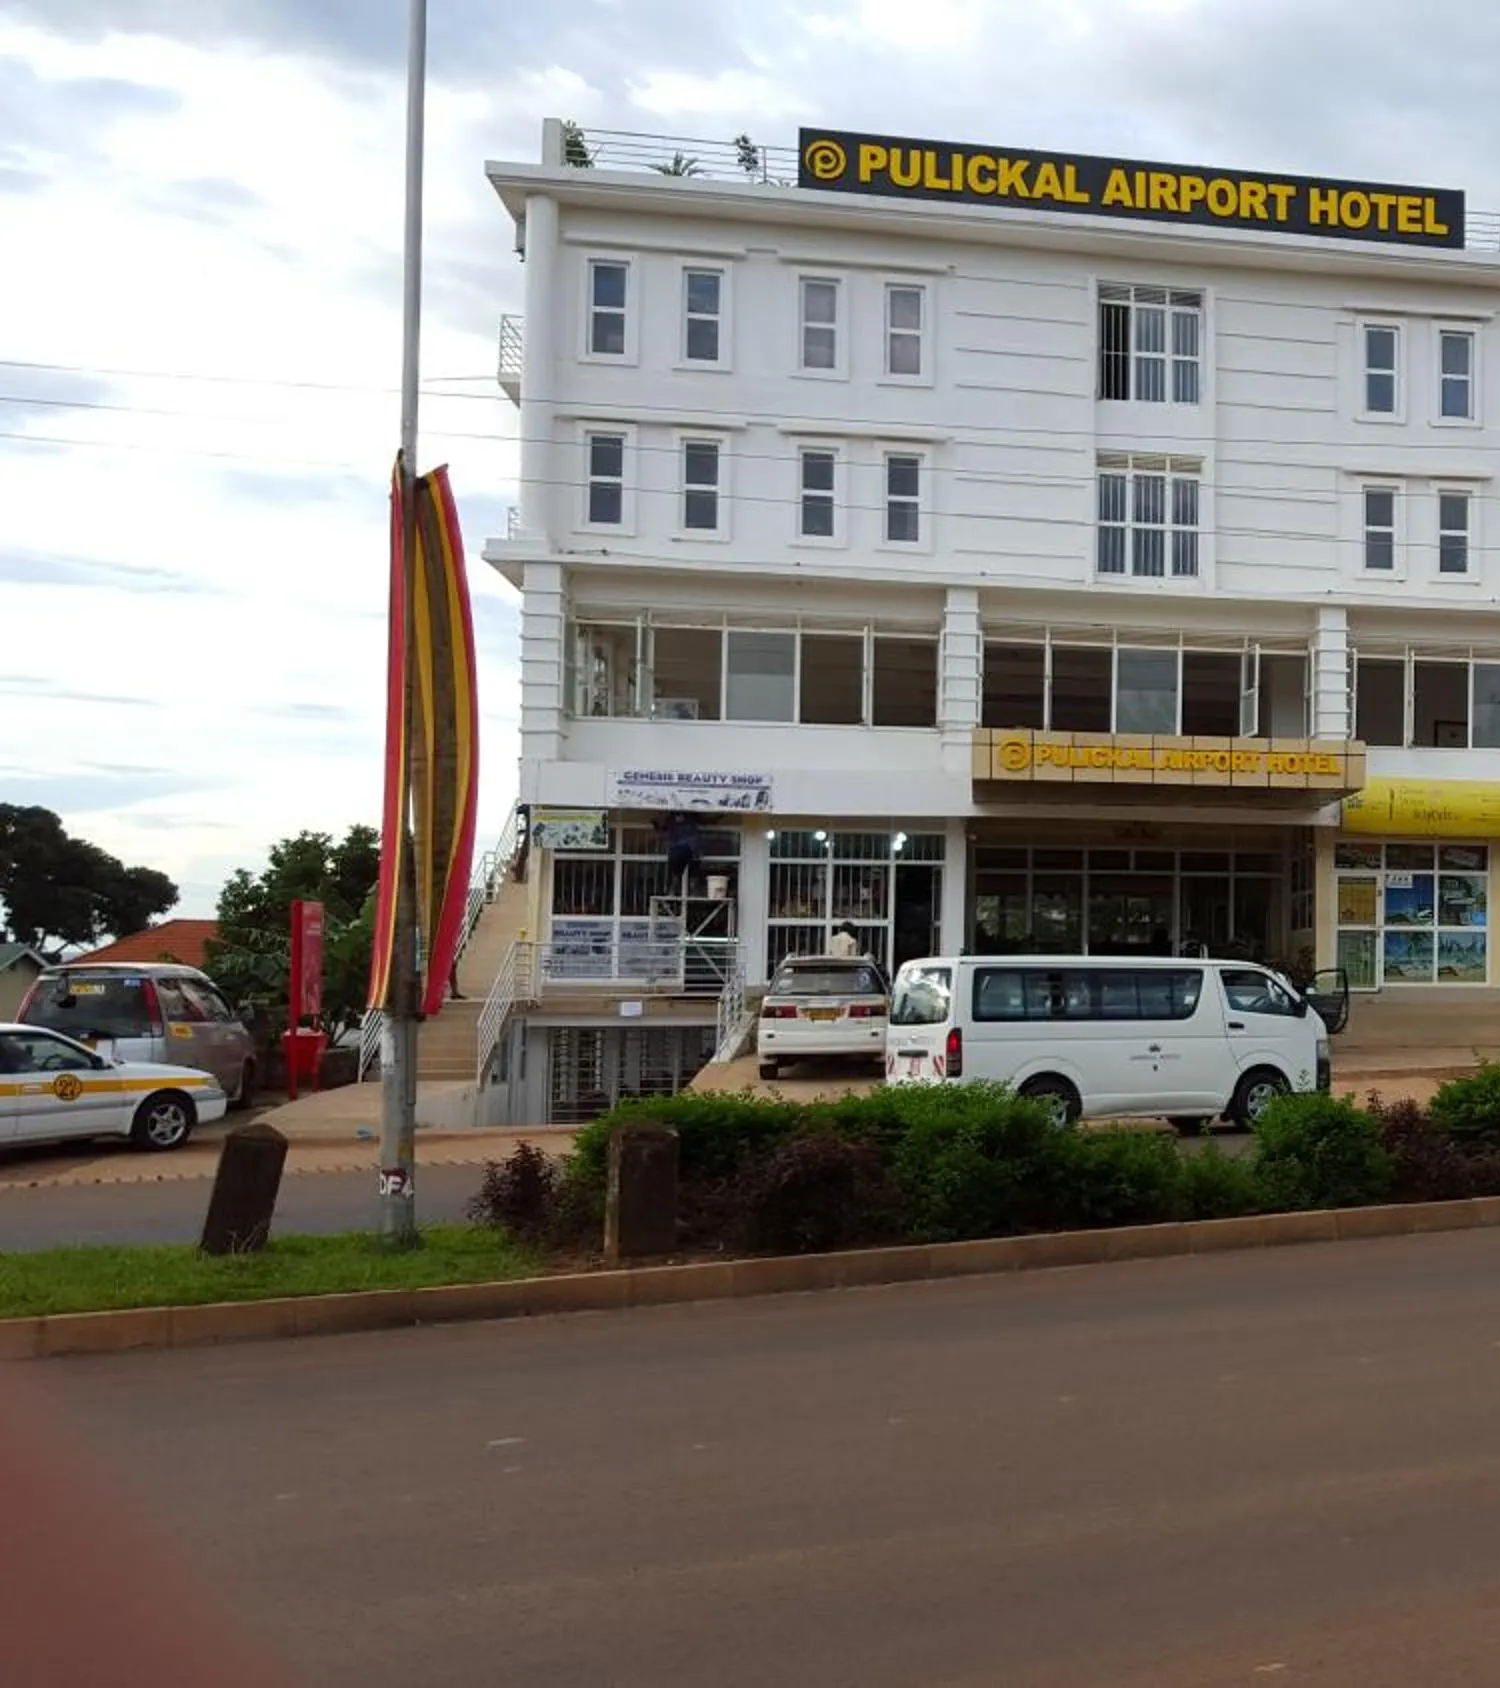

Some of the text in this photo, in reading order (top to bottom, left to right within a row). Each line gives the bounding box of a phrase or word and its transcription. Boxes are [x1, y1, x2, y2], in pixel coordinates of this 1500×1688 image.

[859, 143, 1449, 236] PULICKAL AIRPORT HOTEL
[1035, 744, 1342, 775] PULICKAL AIRPORT HOTEL
[678, 774, 730, 784] BEAUTY
[732, 776, 763, 785] SHOP
